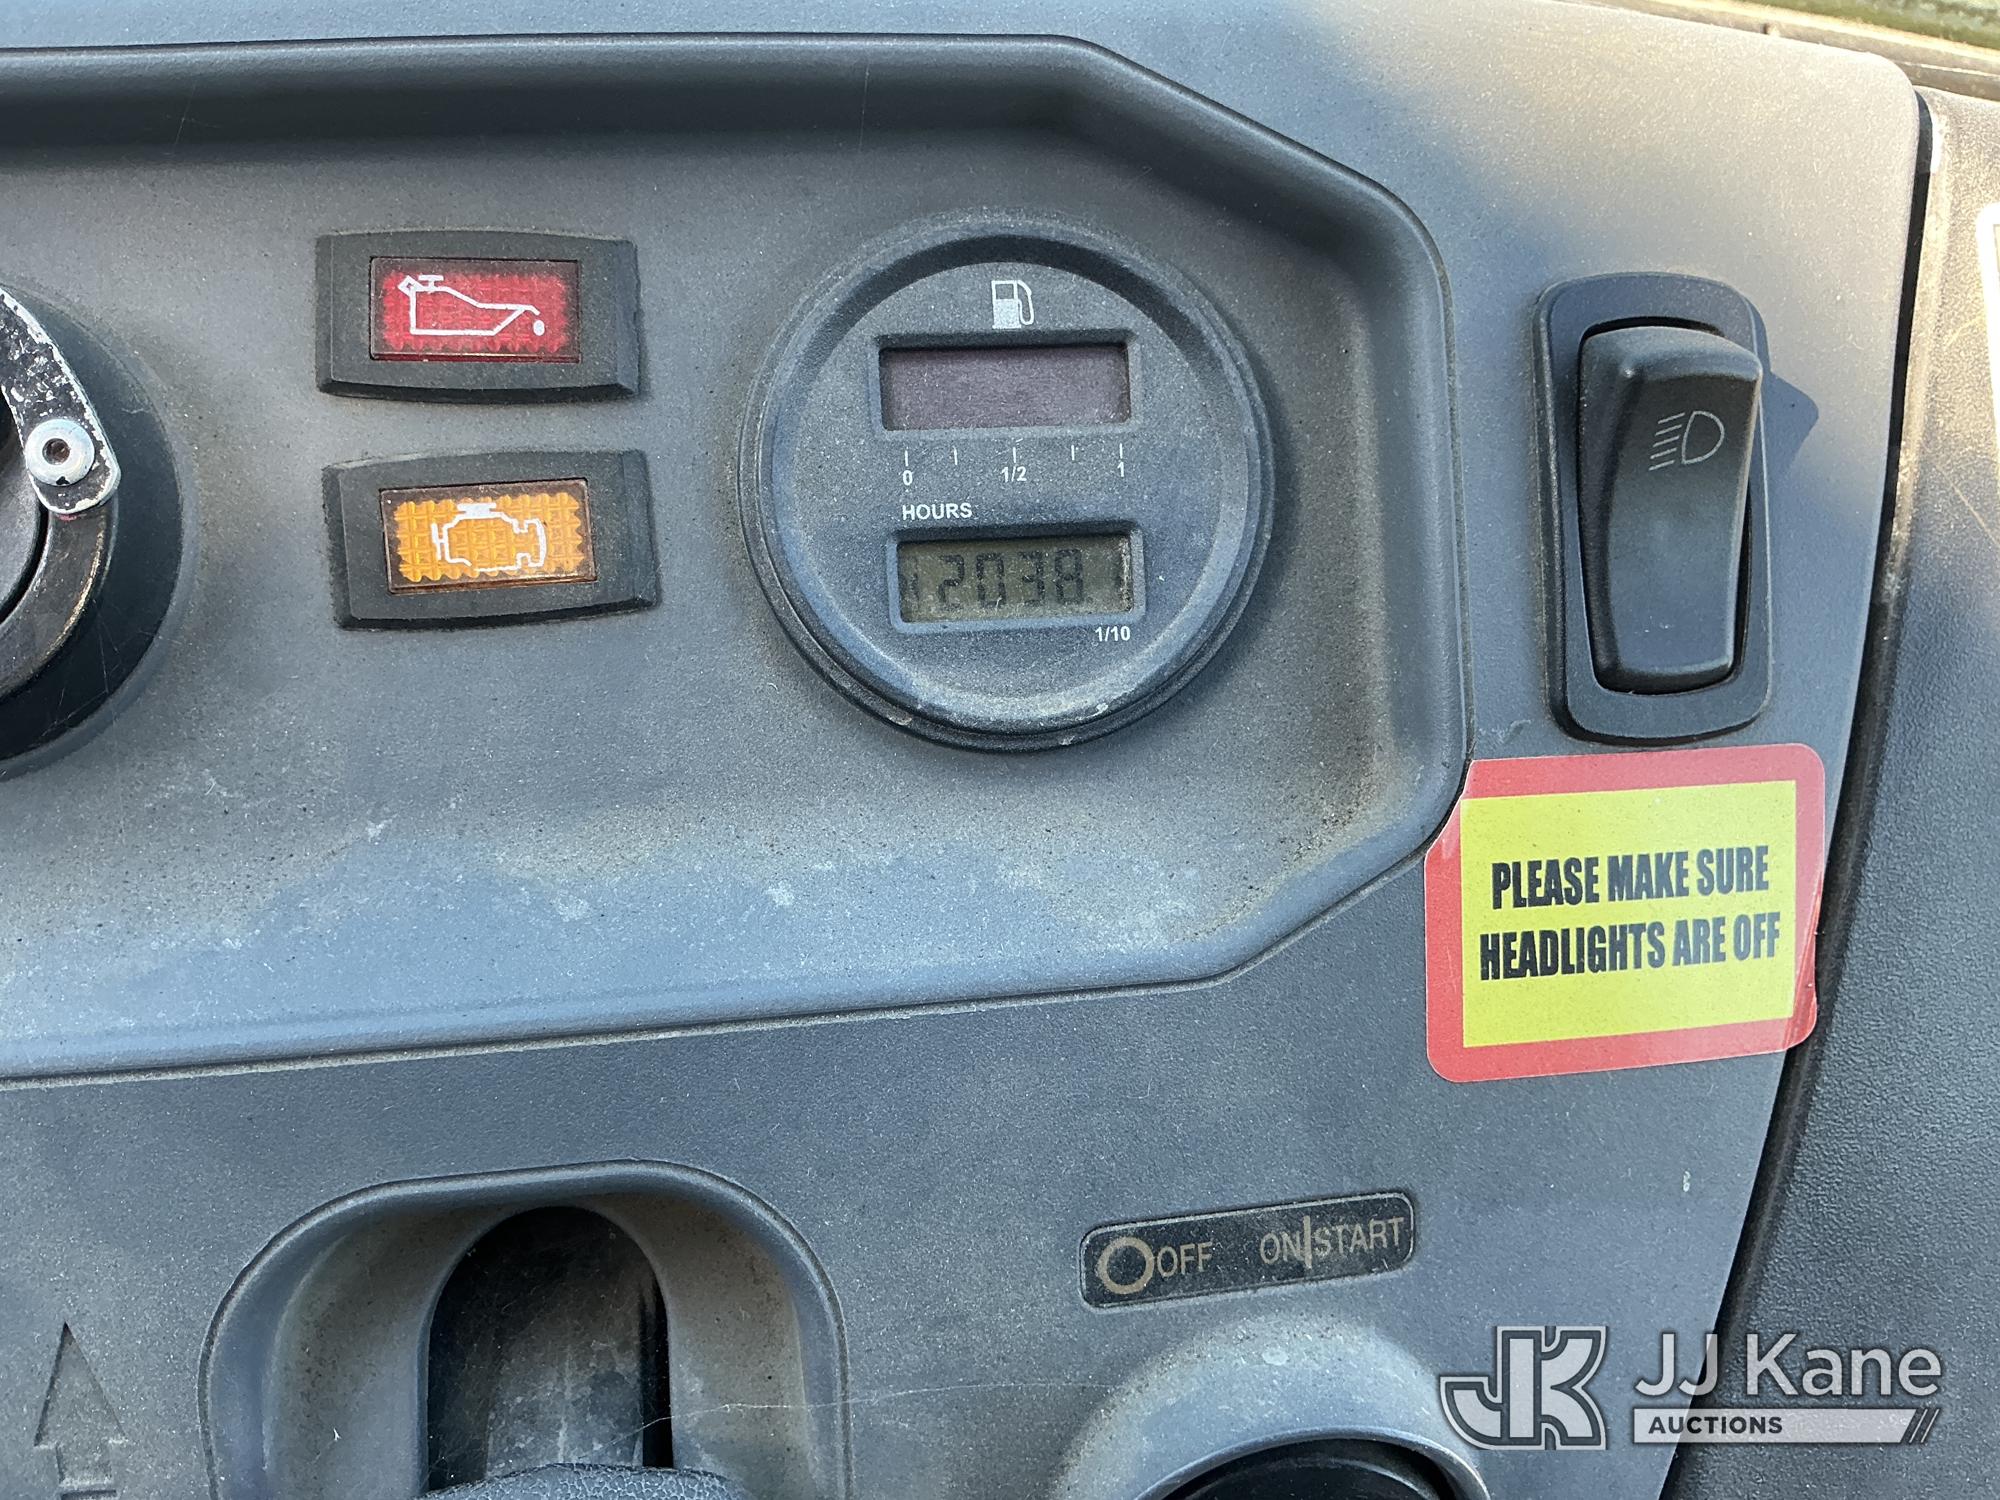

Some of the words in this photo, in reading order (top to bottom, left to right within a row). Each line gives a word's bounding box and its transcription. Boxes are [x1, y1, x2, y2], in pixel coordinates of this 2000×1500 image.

[902, 469, 913, 486] 0
[1001, 465, 1027, 482] 1/2
[902, 502, 973, 520] HOURS
[1095, 625, 1131, 641] 1/10
[1491, 857, 1600, 910] PLEASE
[1606, 851, 1689, 901] MAKE
[1696, 845, 1770, 896] SURE
[1479, 921, 1666, 981] HEADLIGHTS
[1671, 915, 1726, 967] ARE
[1732, 911, 1782, 961] OFF
[1156, 1241, 1214, 1278] OFF
